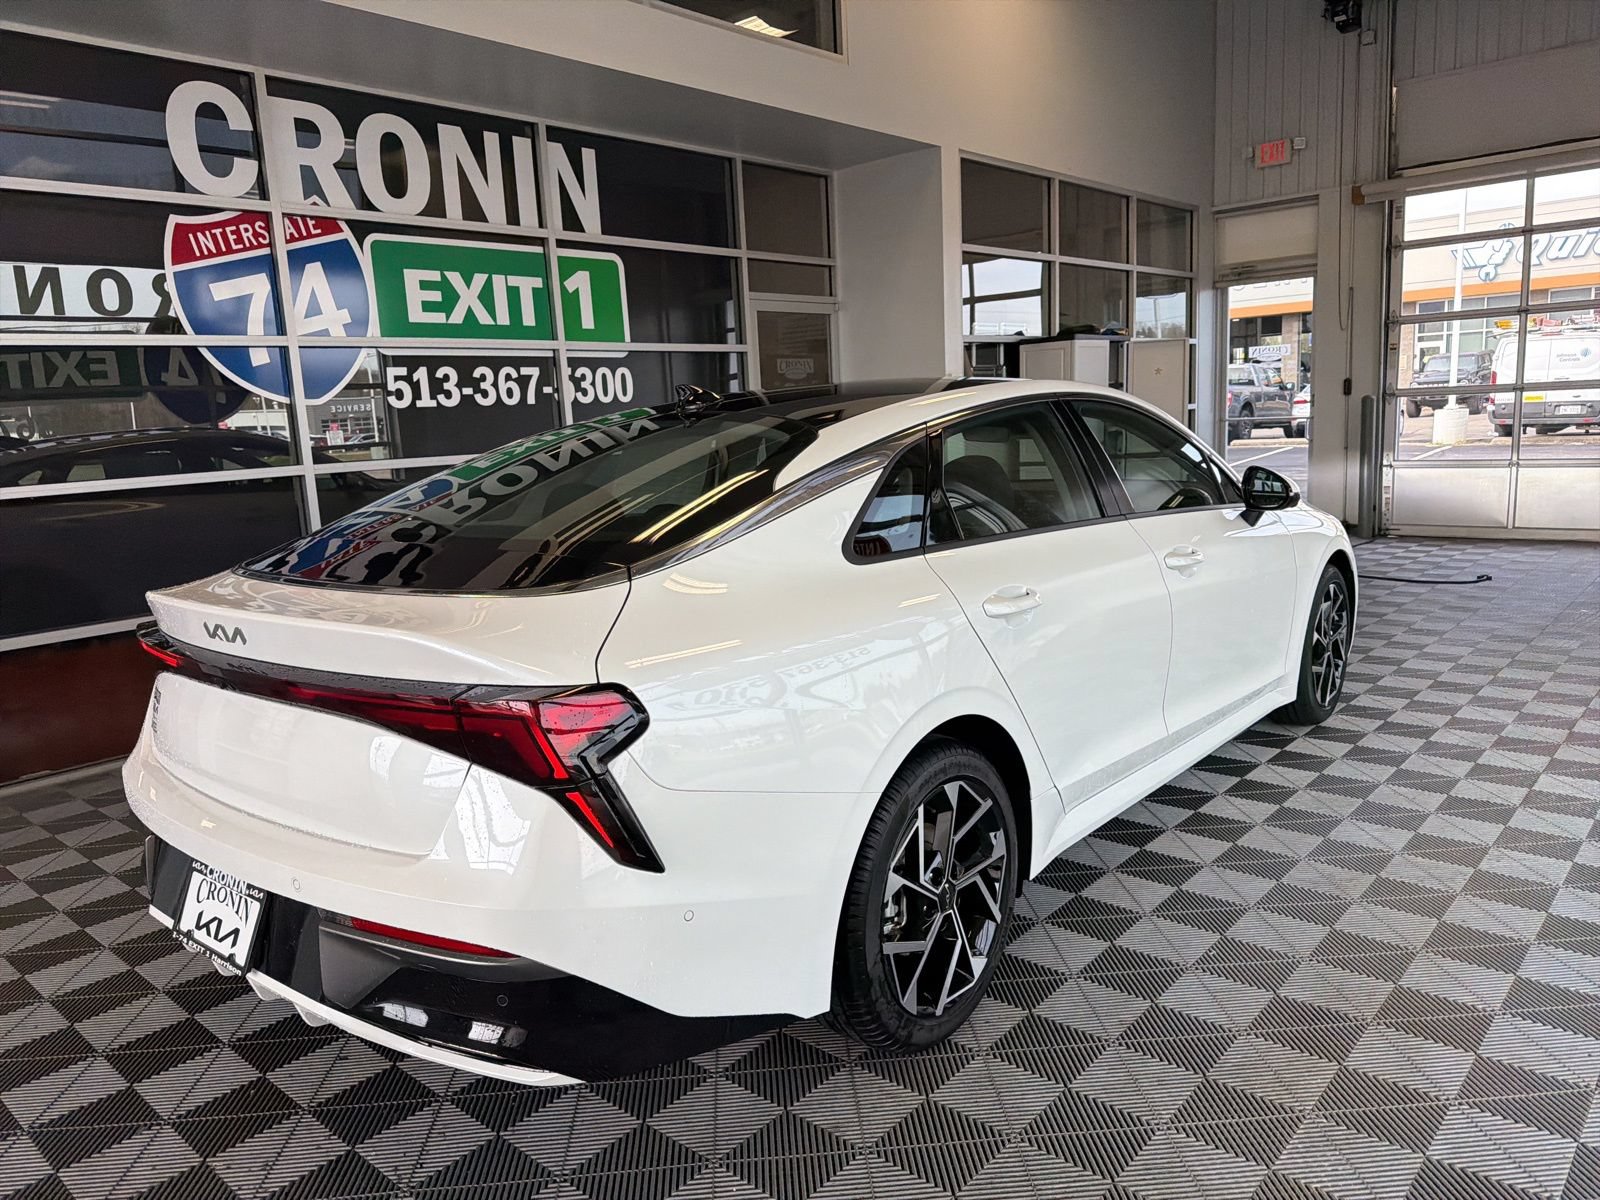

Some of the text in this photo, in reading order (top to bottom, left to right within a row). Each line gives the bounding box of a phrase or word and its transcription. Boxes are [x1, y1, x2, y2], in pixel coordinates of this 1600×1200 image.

[166, 80, 602, 234] CRONIN
[1261, 140, 1285, 164] EXIT
[188, 217, 322, 257] INTERSATE
[1516, 231, 1600, 267] Qui
[209, 261, 352, 367] 74
[403, 268, 596, 330] EXIT 1
[203, 622, 247, 645] KIA
[207, 866, 248, 895] CRONIN
[196, 878, 254, 928] CRONIN
[195, 910, 240, 949] KIA
[188, 940, 206, 954] EXIT
[211, 953, 242, 976] Harrison
